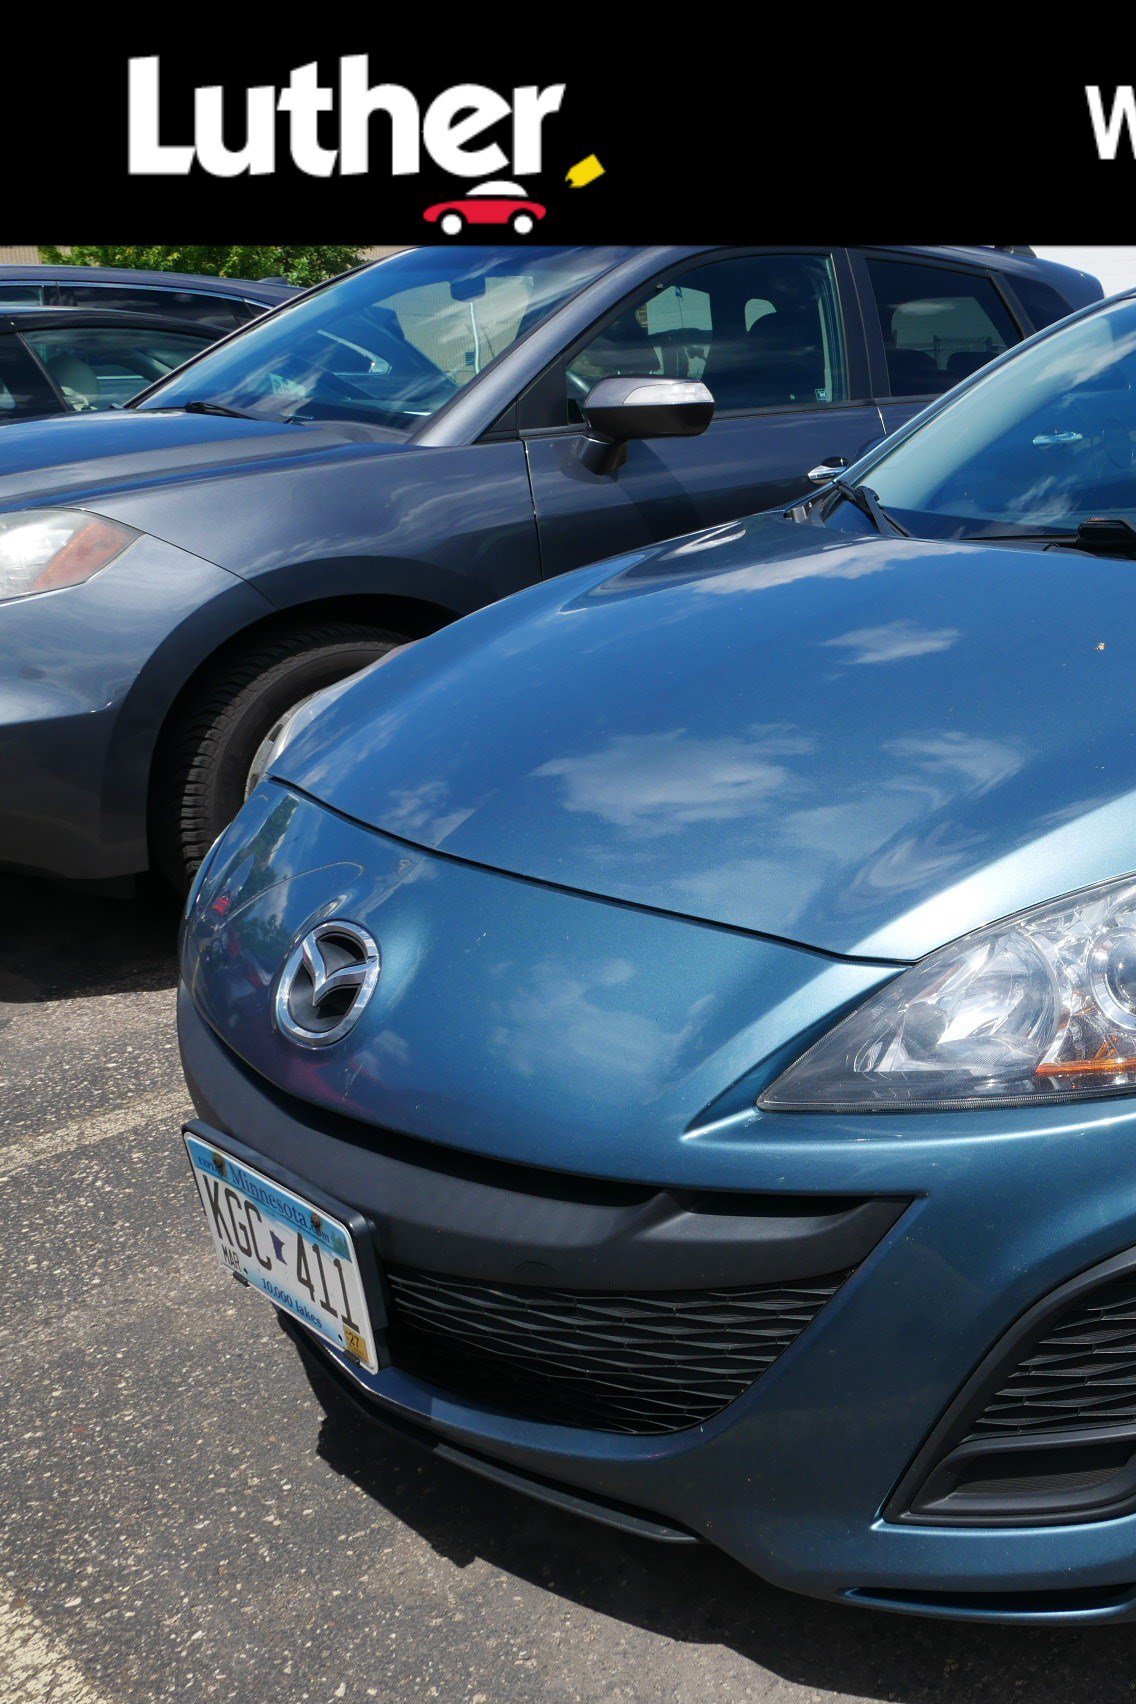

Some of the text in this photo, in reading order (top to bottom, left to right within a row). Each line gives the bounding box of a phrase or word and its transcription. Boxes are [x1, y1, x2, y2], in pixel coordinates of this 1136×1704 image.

[202, 1174, 360, 1334] KGC 411
[294, 1301, 323, 1328] lakes
